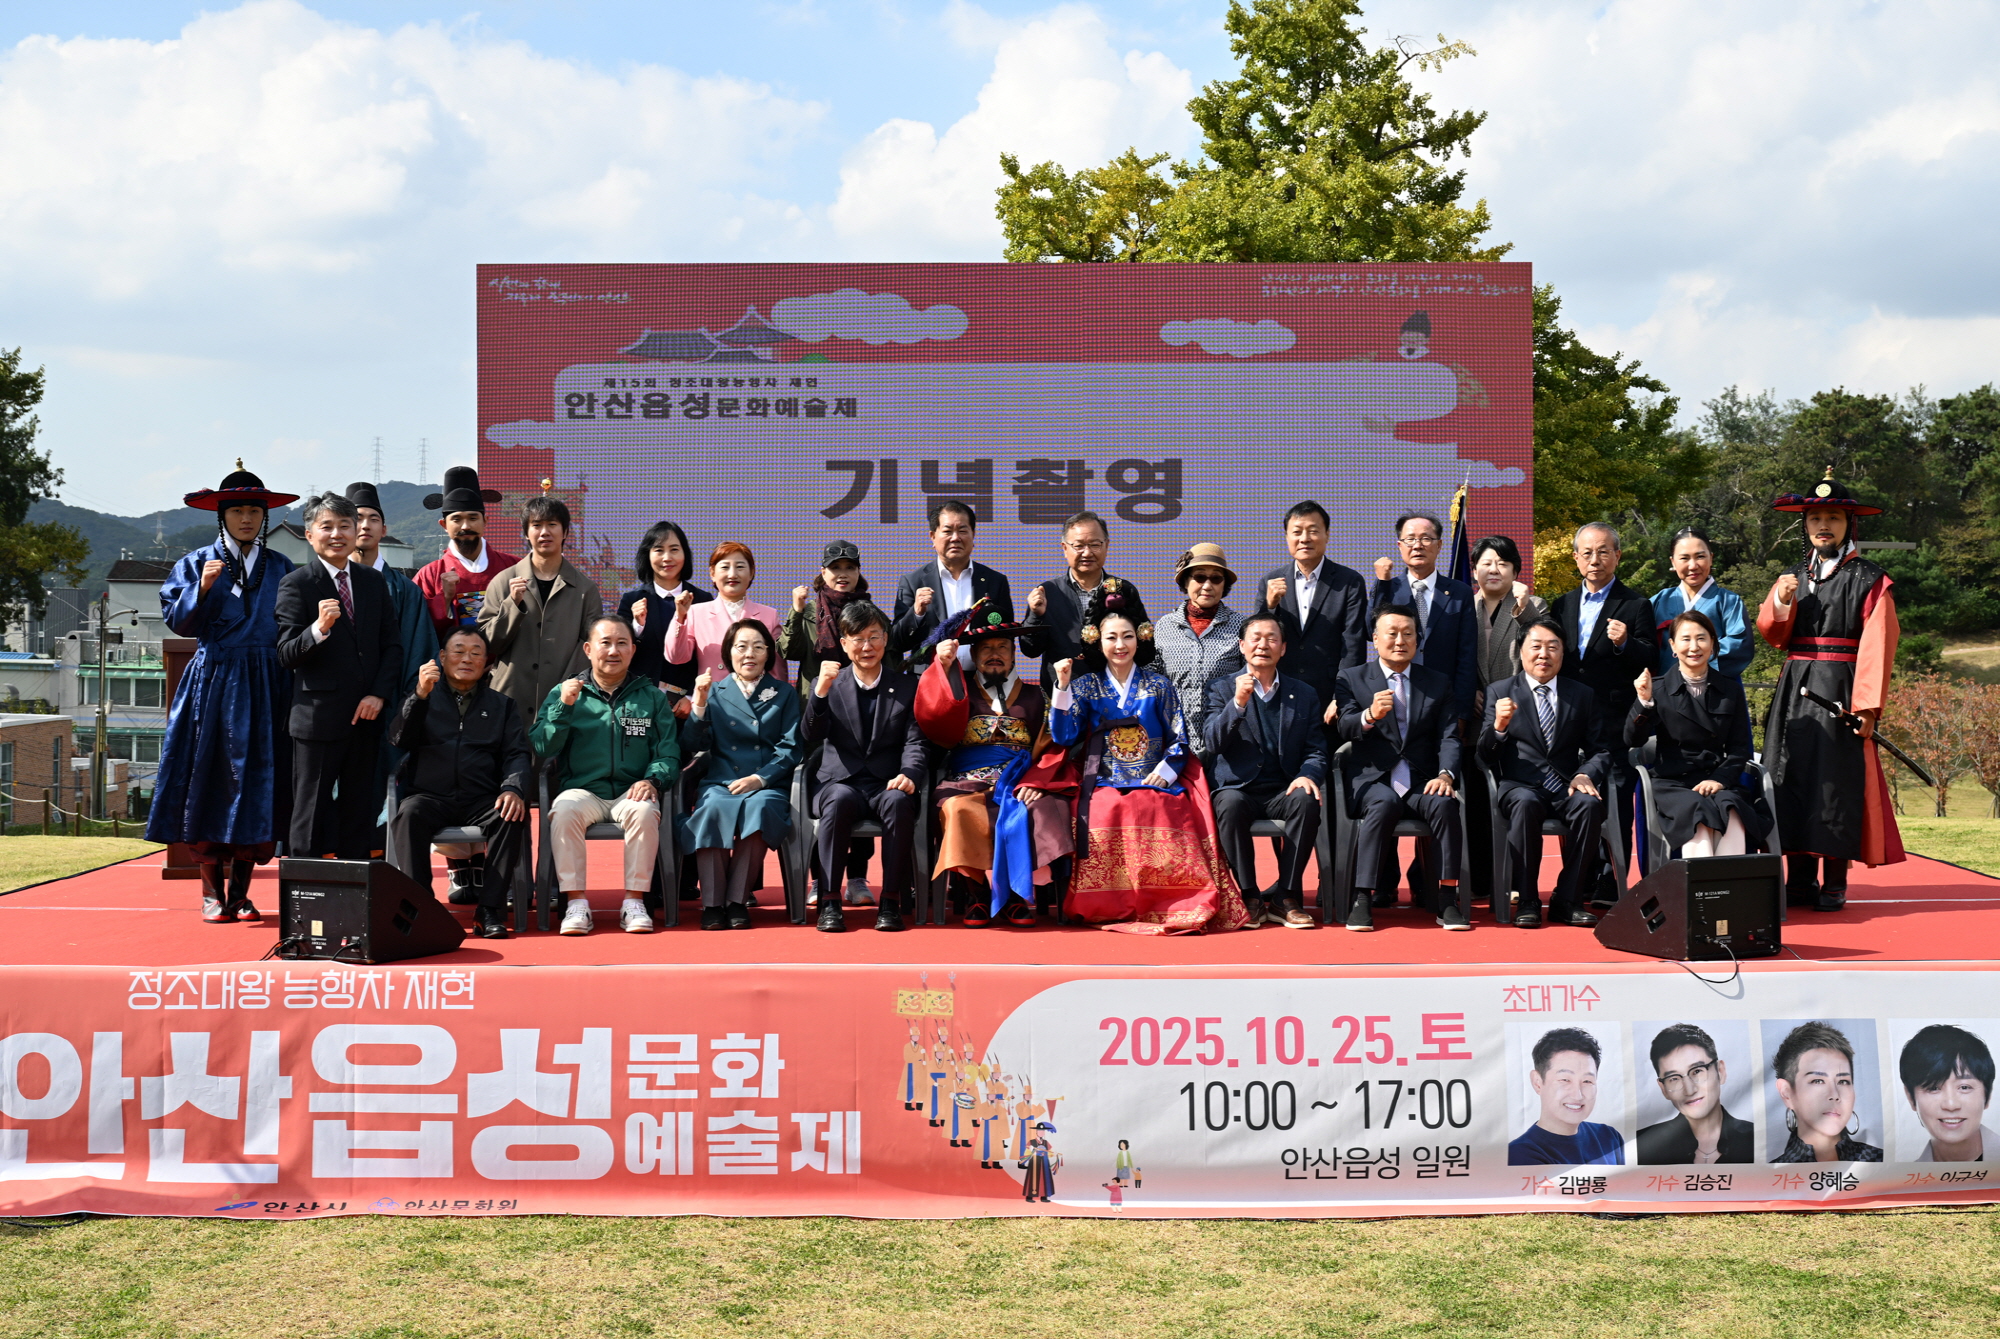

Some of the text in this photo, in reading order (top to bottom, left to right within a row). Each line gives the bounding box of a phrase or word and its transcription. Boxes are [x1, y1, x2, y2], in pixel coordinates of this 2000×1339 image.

[820, 458, 1182, 525] 기념촬영
[620, 717, 652, 728] 경기도의원
[625, 726, 646, 736] 김철진
[128, 970, 475, 1010] 정조대왕 능행차 재현
[1502, 984, 1601, 1012] 초대가수
[626, 1032, 786, 1099] 문화
[0, 1023, 615, 1184] 안산읍성
[1180, 1080, 1297, 1131] 10:00
[1354, 1078, 1473, 1129] 17:00
[624, 1110, 861, 1176] 예술제
[1280, 1145, 1471, 1180] 안산읍성 일원
[1521, 1175, 1608, 1195] 가수 김범룡
[1646, 1174, 1733, 1192] 가수 김승진
[1772, 1171, 1860, 1192] 가수 양혜승
[1903, 1172, 1936, 1185] 가수
[263, 1202, 347, 1214] 안산시
[404, 1199, 518, 1211] 안산문화원
